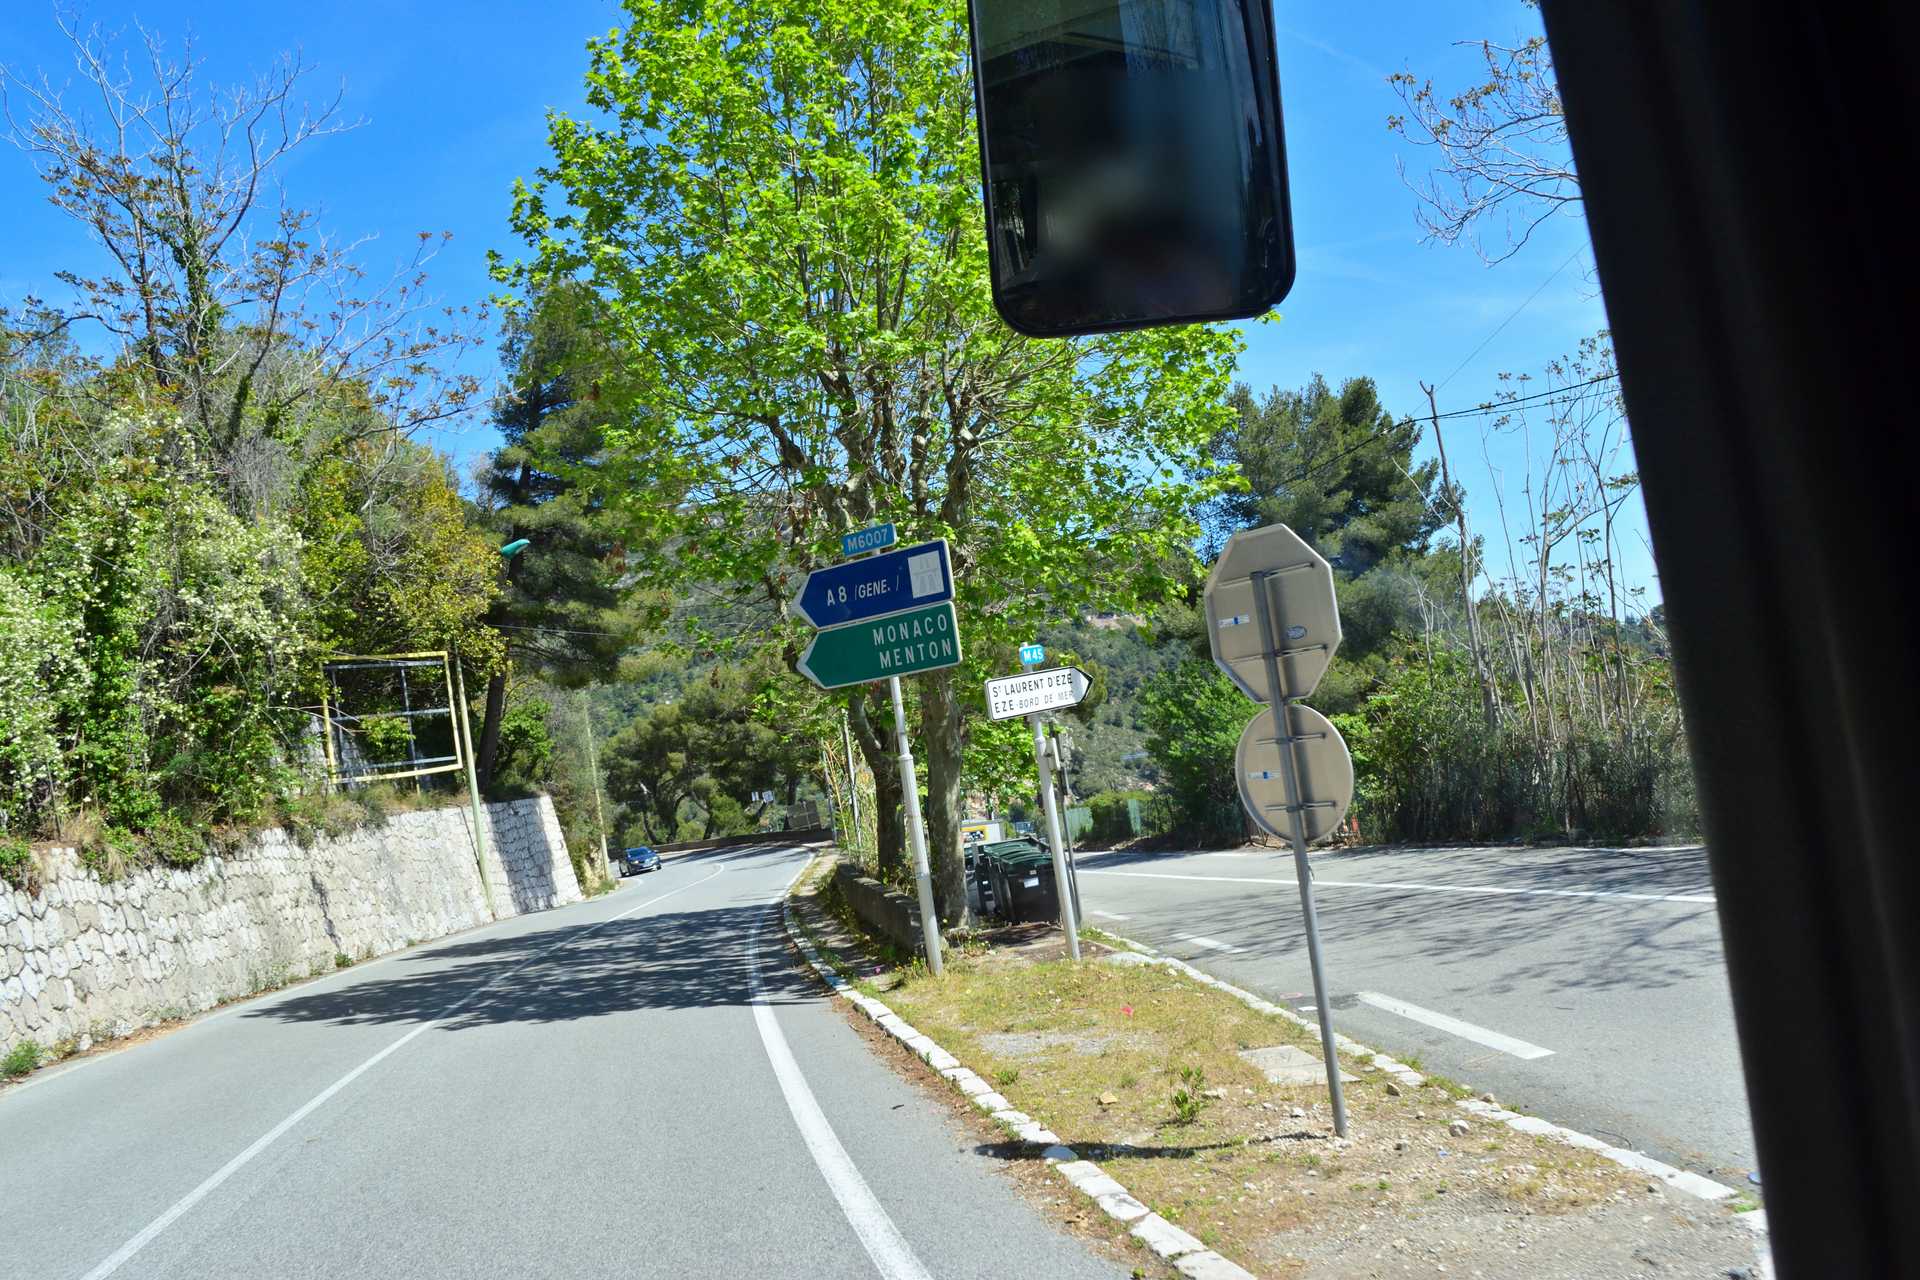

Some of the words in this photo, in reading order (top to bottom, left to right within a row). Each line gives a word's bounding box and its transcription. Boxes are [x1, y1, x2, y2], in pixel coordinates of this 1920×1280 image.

[847, 528, 888, 552] M6007
[873, 614, 947, 645] MONACO
[879, 639, 952, 668] MENTON
[1023, 648, 1044, 662] M45
[1004, 679, 1044, 695] LAURENT
[1044, 694, 1053, 704] DE
